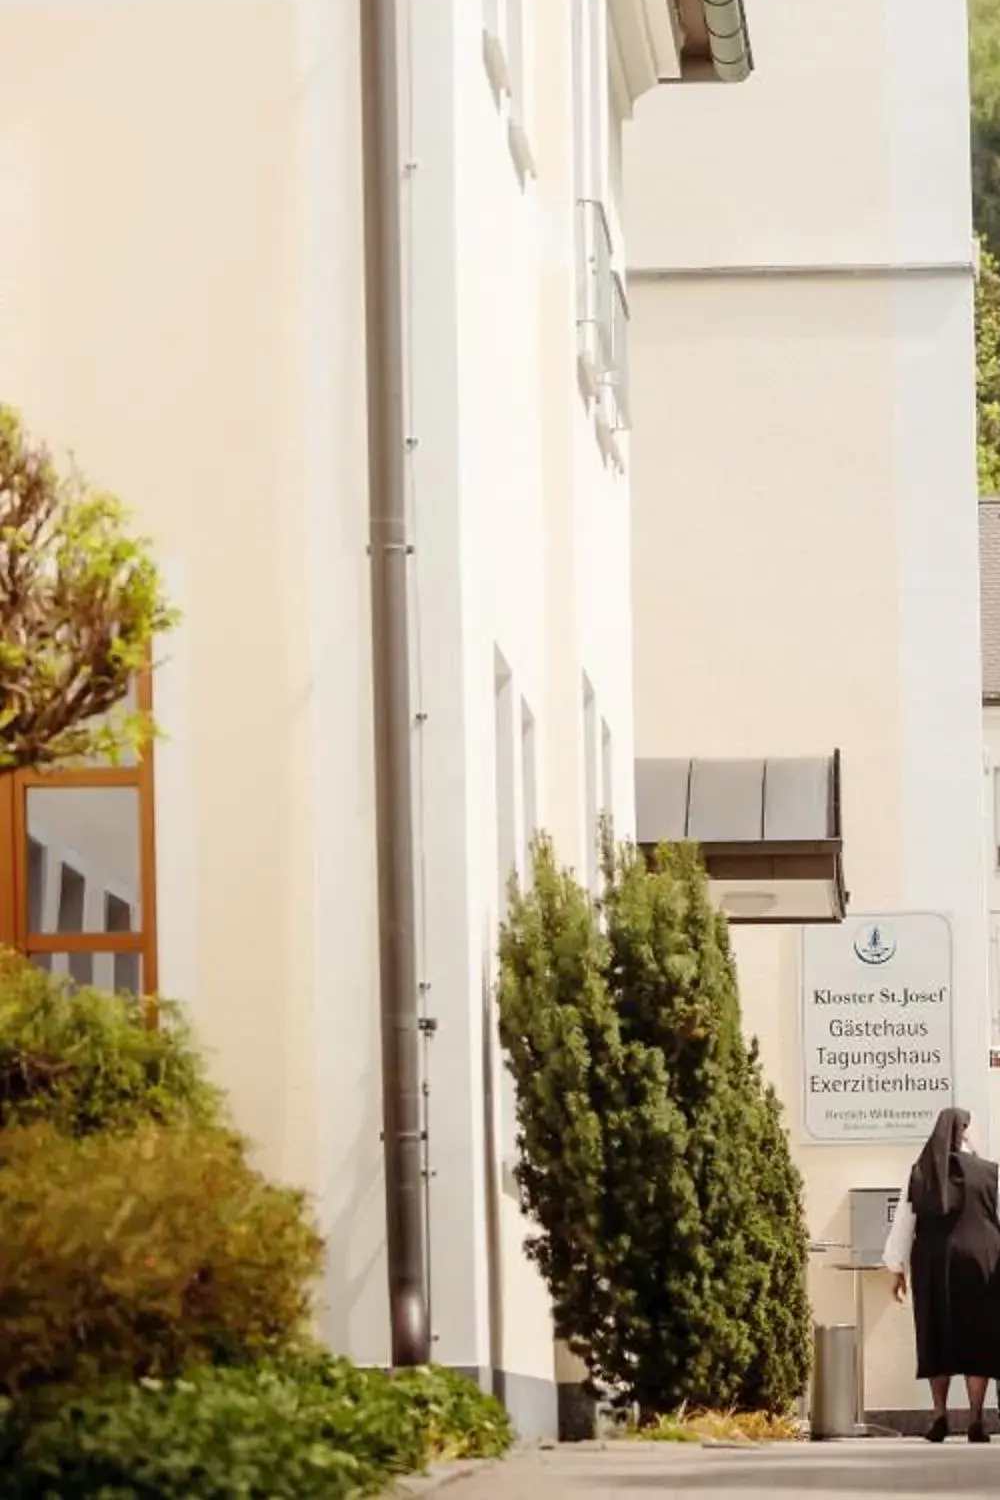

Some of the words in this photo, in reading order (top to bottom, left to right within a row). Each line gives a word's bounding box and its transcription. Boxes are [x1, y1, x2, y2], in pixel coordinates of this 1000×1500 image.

[813, 988, 875, 1005] Kloster
[829, 1018, 928, 1037] Gästehaus
[816, 1045, 941, 1070] Tagungshaus
[810, 1073, 949, 1093] Exerzitienhaus
